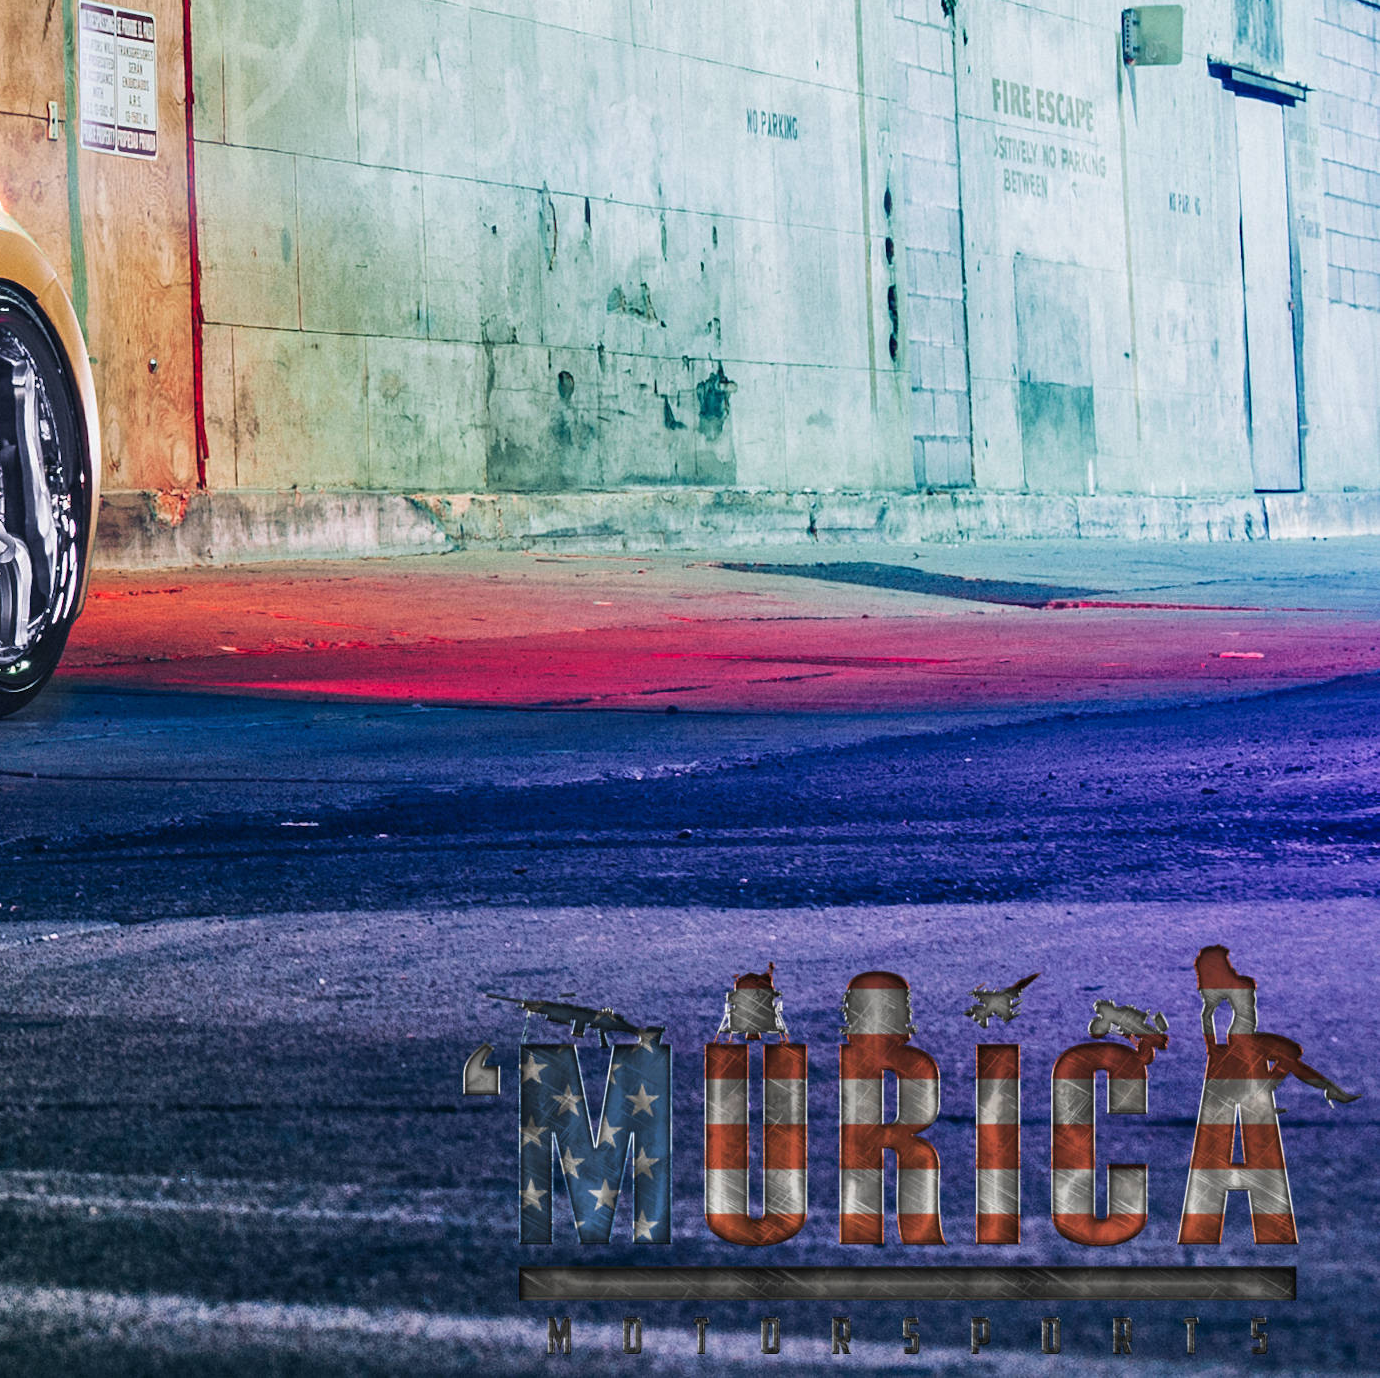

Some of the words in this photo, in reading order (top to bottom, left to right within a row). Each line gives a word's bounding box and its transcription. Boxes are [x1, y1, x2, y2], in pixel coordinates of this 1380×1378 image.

[992, 77, 1032, 119] FIRE
[1036, 88, 1094, 133] ESCAPE
[746, 108, 758, 134] NO
[761, 111, 798, 140] PARKING
[1042, 144, 1057, 169] NO
[1061, 148, 1107, 178] PARKING
[1003, 168, 1048, 199] BETWEEN
